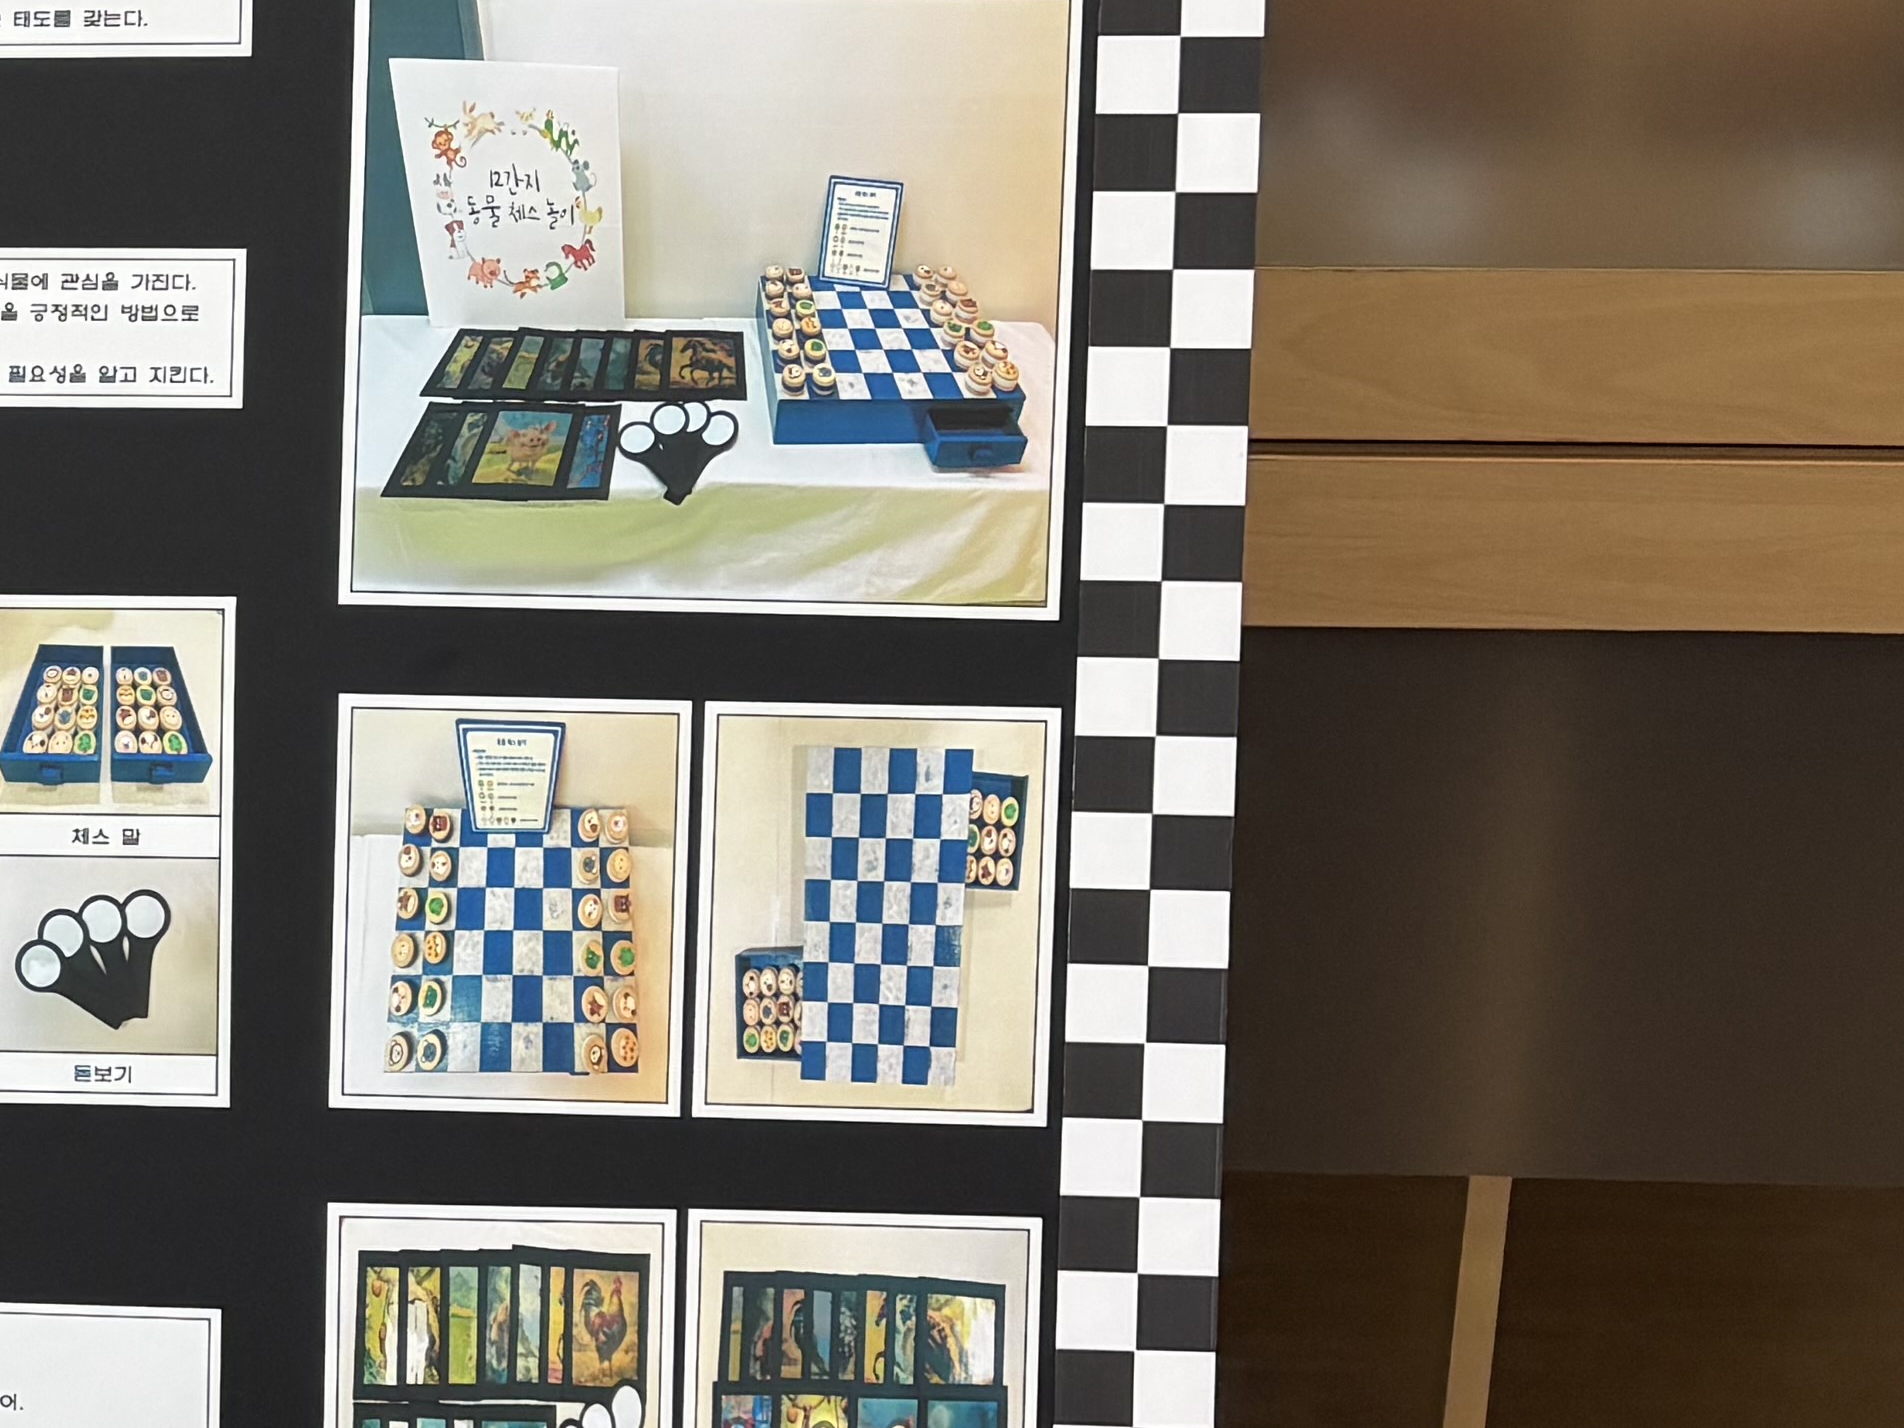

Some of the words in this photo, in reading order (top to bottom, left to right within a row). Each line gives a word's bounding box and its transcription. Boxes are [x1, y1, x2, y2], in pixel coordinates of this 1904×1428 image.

[13, 9, 72, 28] 태도를
[83, 9, 148, 28] 갖는다.
[489, 163, 541, 195] 12간지
[60, 271, 119, 291] 관심을
[130, 273, 196, 292] 가진다.
[30, 303, 109, 323] 긍정적인
[120, 304, 200, 323] 방법으로
[8, 363, 87, 385] 필요성을
[98, 365, 137, 384] 알고
[148, 365, 214, 385] 지킨다.
[71, 827, 110, 845] 체스
[121, 828, 141, 846] 말
[74, 1064, 132, 1084] 돋보기
